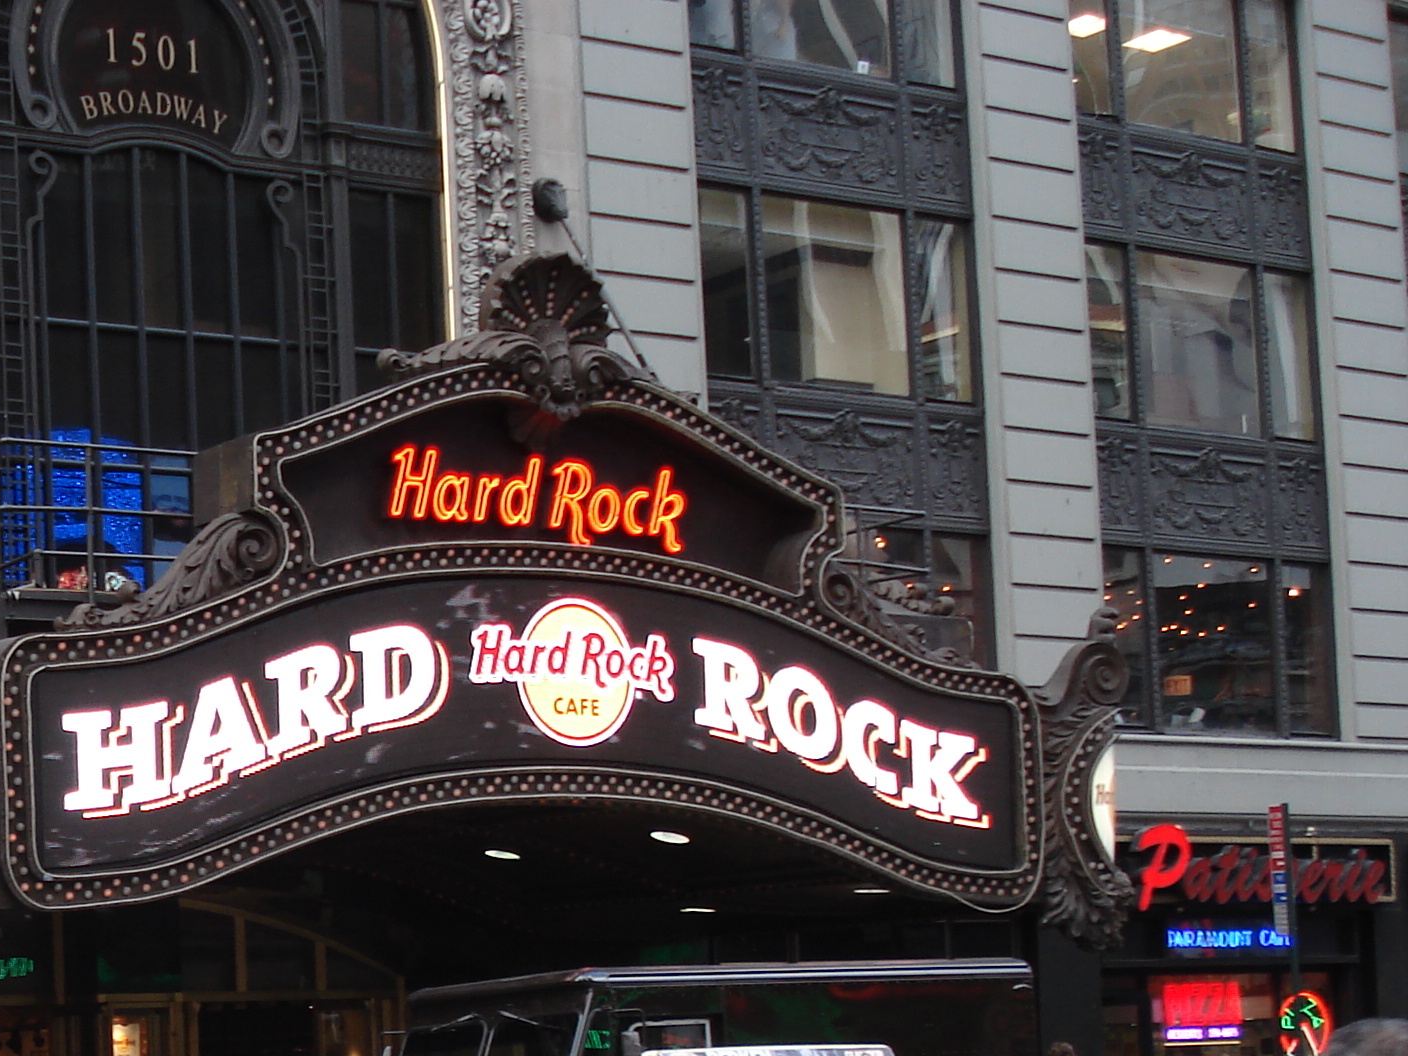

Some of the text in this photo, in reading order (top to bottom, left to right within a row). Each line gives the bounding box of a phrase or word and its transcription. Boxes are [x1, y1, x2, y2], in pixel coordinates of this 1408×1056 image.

[106, 27, 198, 73] 1501
[81, 89, 227, 135] BROADWAY
[389, 446, 686, 553] Hard Rock
[476, 630, 668, 694] Hard Rock
[62, 624, 450, 818] HARD
[553, 697, 600, 716] CAFE
[692, 637, 992, 829] ROCK
[1166, 929, 1253, 948] PARAMOUNT
